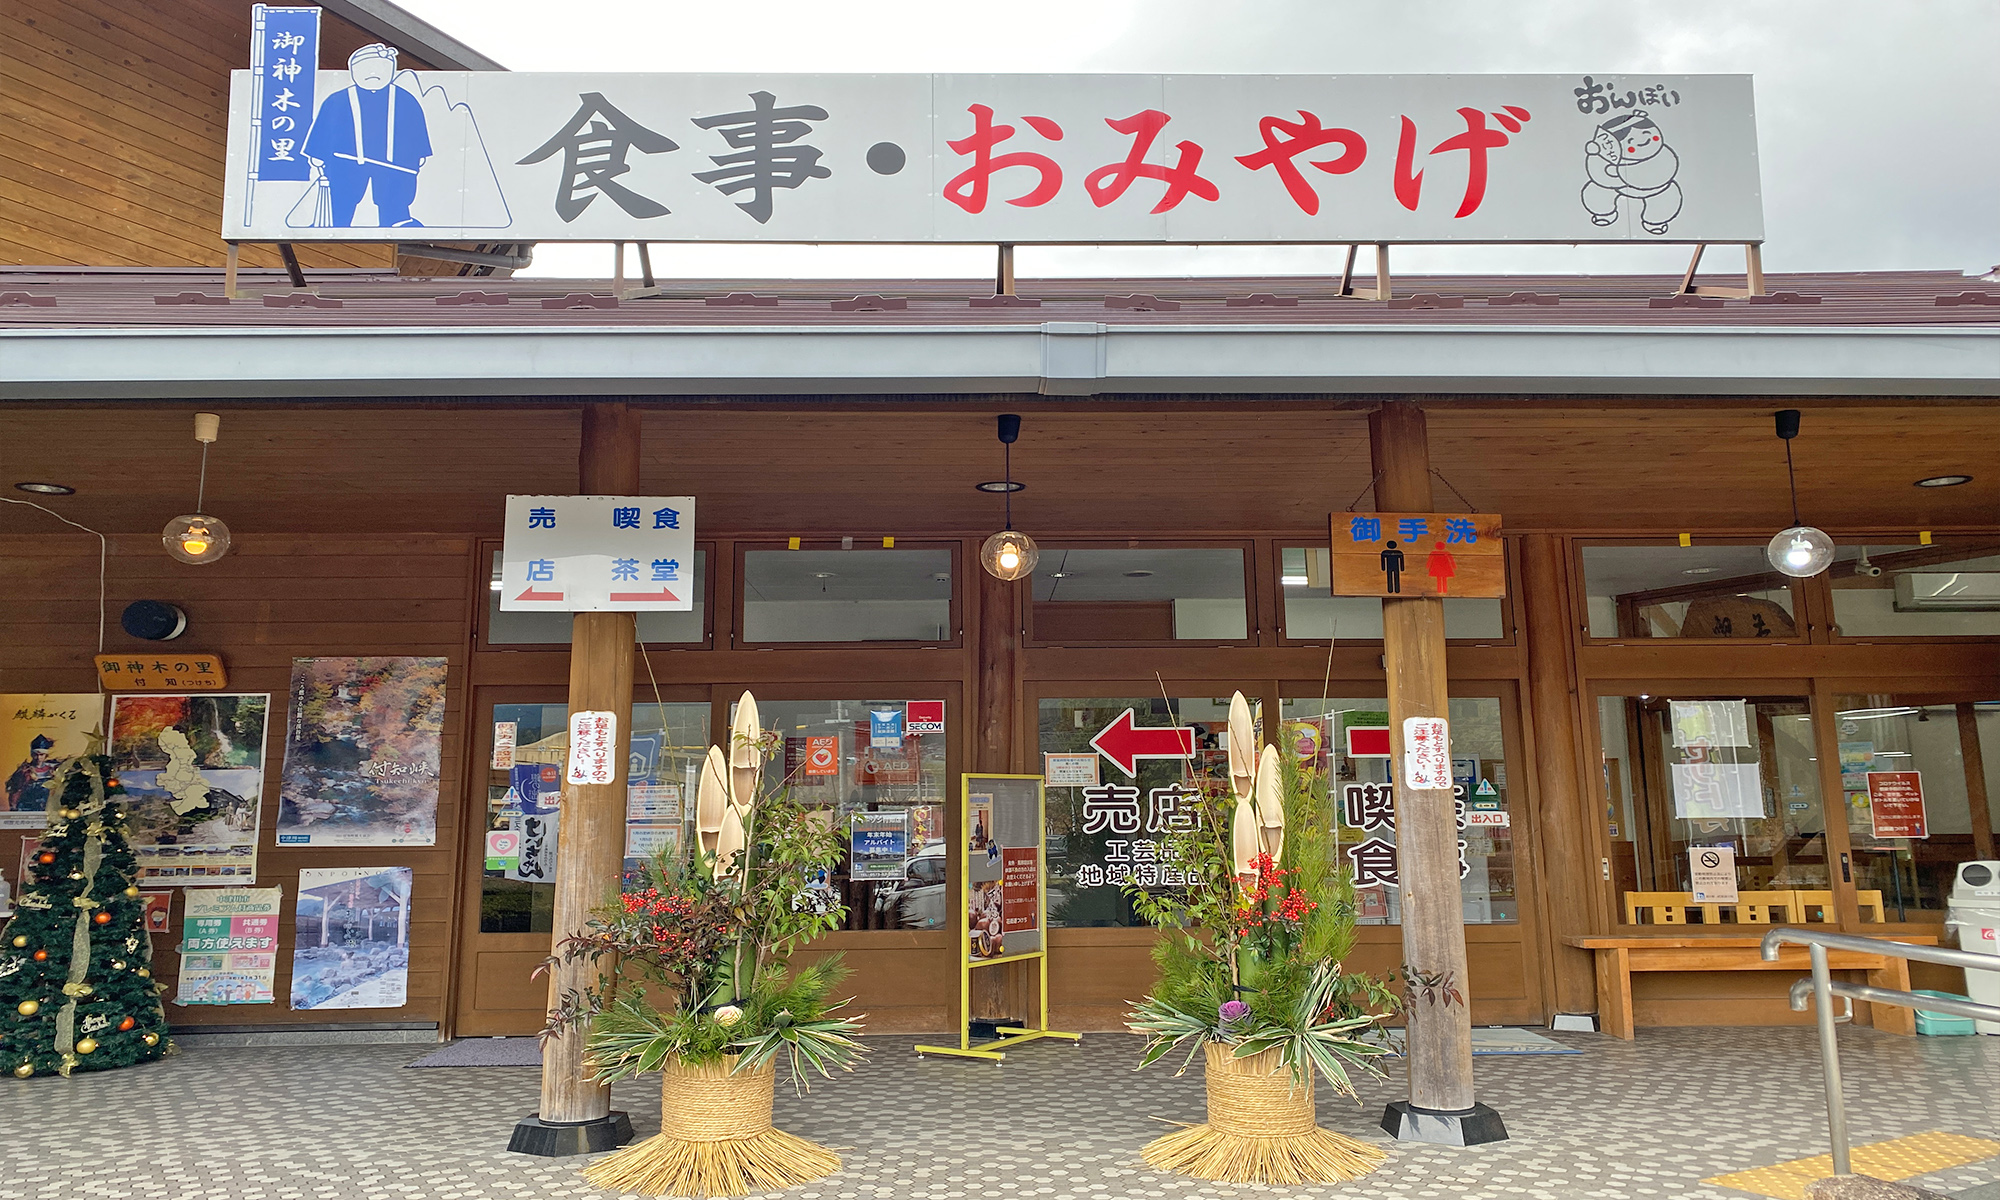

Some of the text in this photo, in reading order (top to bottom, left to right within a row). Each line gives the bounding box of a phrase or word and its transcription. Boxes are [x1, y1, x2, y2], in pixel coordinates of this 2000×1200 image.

[268, 31, 305, 161] 御神木の里
[1574, 75, 1680, 114] おんぽい
[1350, 517, 1477, 543] 御手洗
[102, 660, 214, 674] 御神木の里
[12, 708, 76, 720] 麒麟がくる
[592, 717, 609, 782] お足もとすべりますので
[1431, 723, 1447, 788] お足もとすべりますので
[369, 760, 434, 777] 付知峡
[883, 761, 909, 770] AED
[1082, 783, 1202, 834] 売店
[1472, 814, 1503, 823] 出入口
[187, 937, 272, 950] 両方使えます
